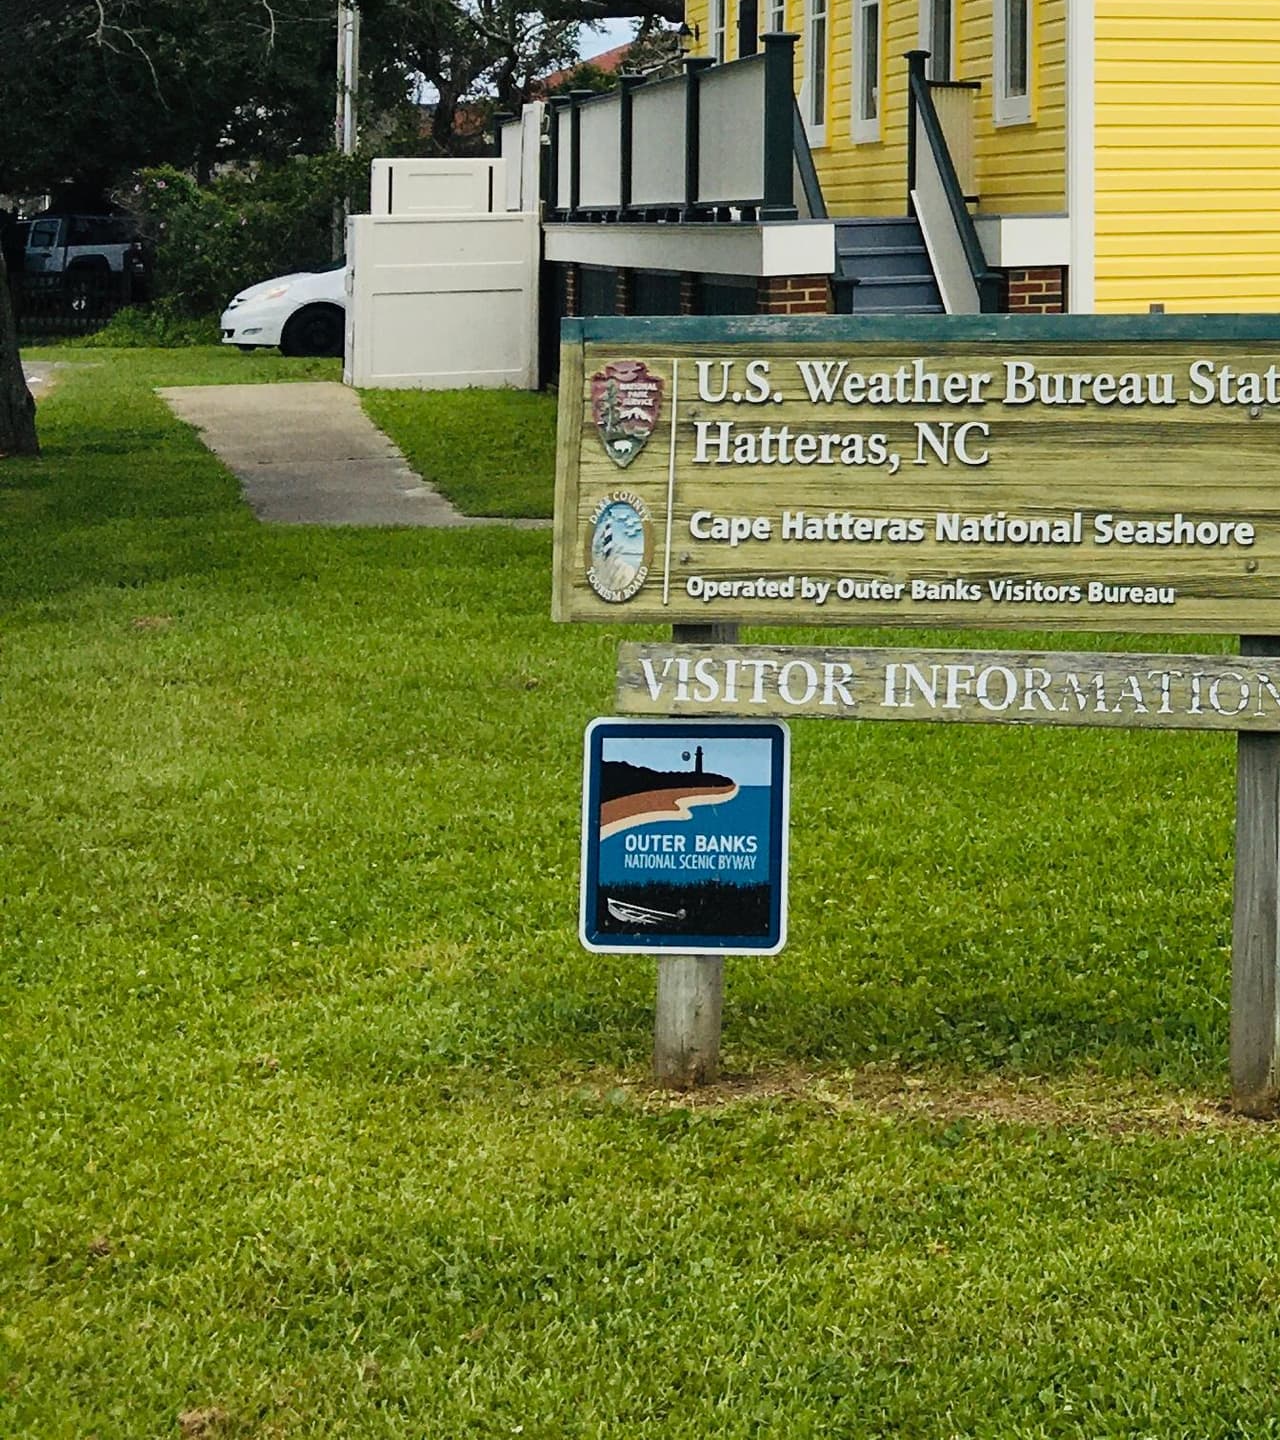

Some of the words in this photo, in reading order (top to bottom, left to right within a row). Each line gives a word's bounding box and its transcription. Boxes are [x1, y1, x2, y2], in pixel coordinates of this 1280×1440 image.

[695, 359, 783, 403] U.S.
[796, 359, 991, 404] Weather
[1002, 361, 1176, 405] Bureau
[692, 421, 901, 474] Hatteras,
[913, 421, 990, 465] NC
[689, 511, 771, 548] Cape
[782, 511, 924, 541] Hatteras
[935, 511, 1082, 543] National
[1094, 513, 1255, 545] Seashore
[686, 576, 795, 601] Operated
[801, 577, 831, 603] by
[837, 578, 905, 600] Outer
[911, 579, 981, 601] Banks
[989, 580, 1081, 602] Visitors
[1087, 582, 1176, 604] Bureau
[638, 658, 855, 706] VISITOR
[624, 854, 677, 869] NATIONAL
[679, 854, 716, 869] SCENIC
[718, 855, 757, 870] BYWAY
[625, 834, 686, 852] OUTER
[695, 835, 758, 853] BANKS
